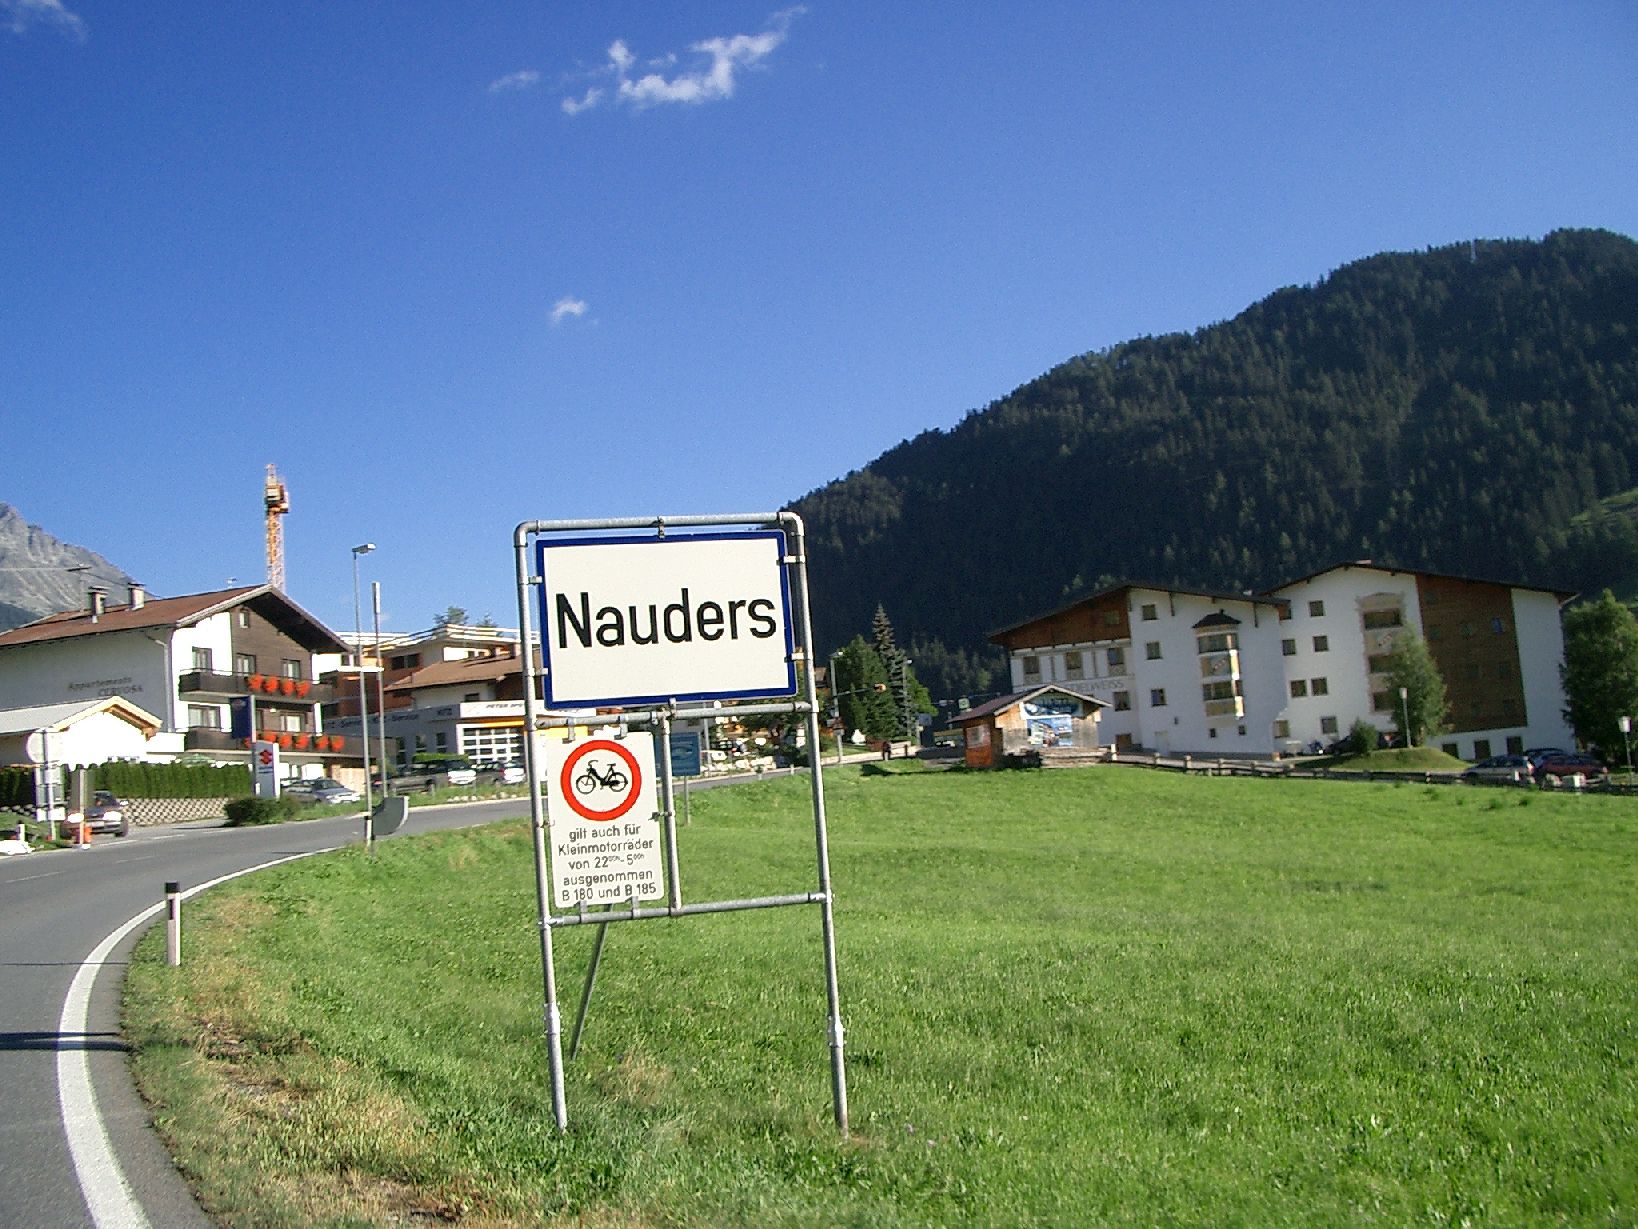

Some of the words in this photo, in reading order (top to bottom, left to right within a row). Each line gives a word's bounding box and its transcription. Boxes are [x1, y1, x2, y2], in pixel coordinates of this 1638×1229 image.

[555, 587, 777, 649] Nauders
[569, 827, 587, 842] gilt
[591, 824, 620, 838] auch
[624, 823, 641, 835] für
[558, 838, 654, 857] Kleinmotorräder
[568, 860, 590, 870] von
[563, 870, 653, 887] ausgenommen
[562, 890, 570, 901] B
[574, 888, 594, 900] 180
[598, 885, 621, 898] und
[625, 884, 633, 896] B
[636, 882, 657, 895] 185
